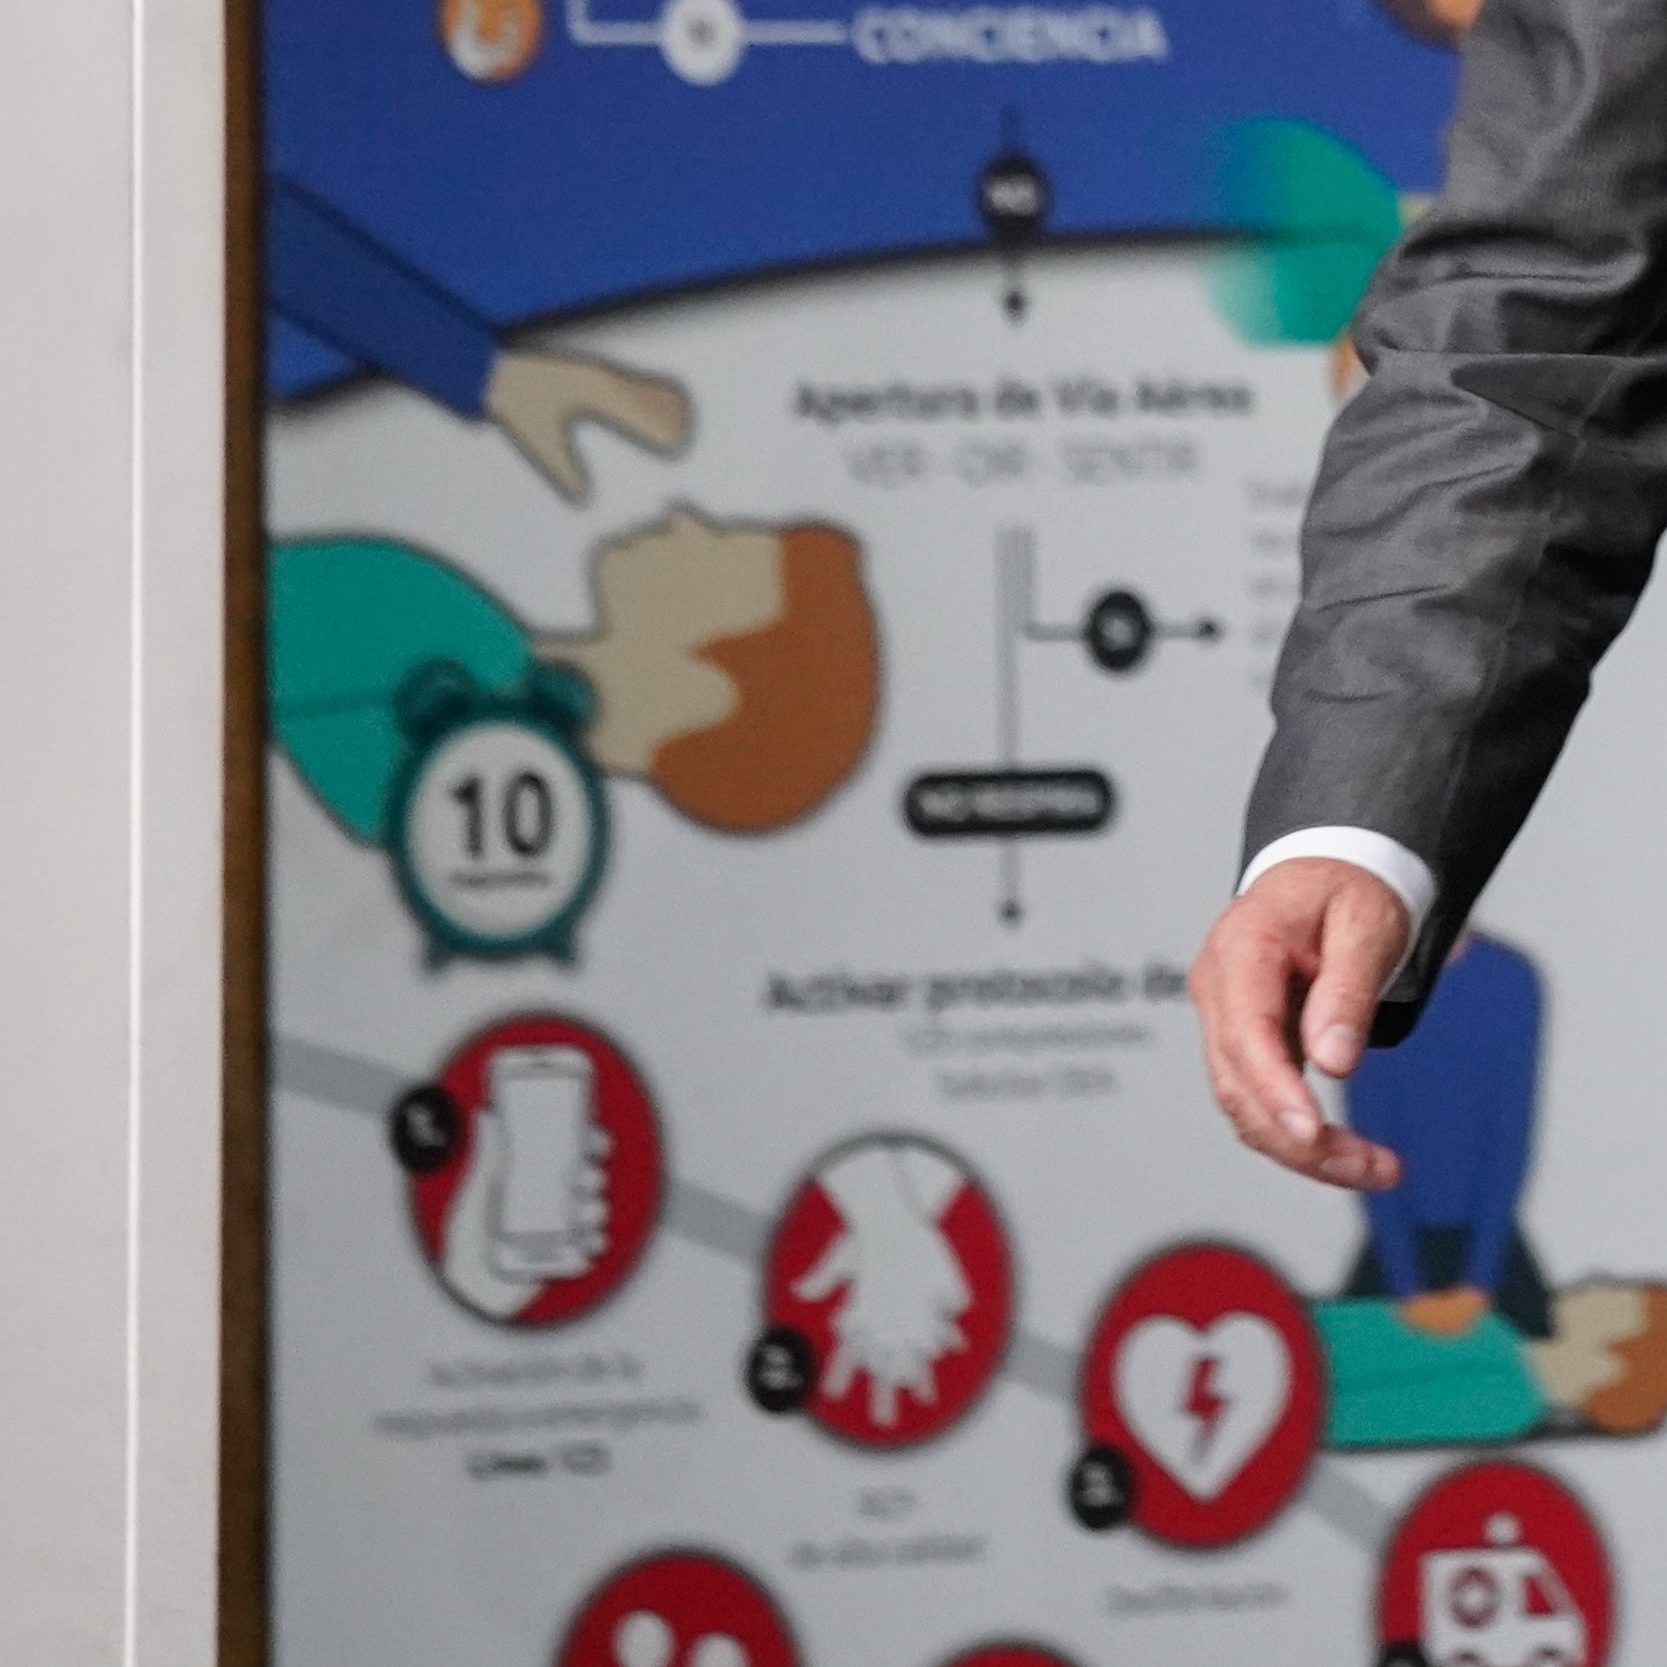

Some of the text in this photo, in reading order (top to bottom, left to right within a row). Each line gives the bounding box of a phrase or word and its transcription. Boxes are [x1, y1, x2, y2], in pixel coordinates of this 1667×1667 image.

[854, 6, 1169, 64] CONCIENCIA
[797, 376, 1256, 426] Apertura de Vía Aérea
[452, 770, 552, 859] 10
[769, 972, 908, 1014] Activar
[925, 970, 1124, 1026] protocolo
